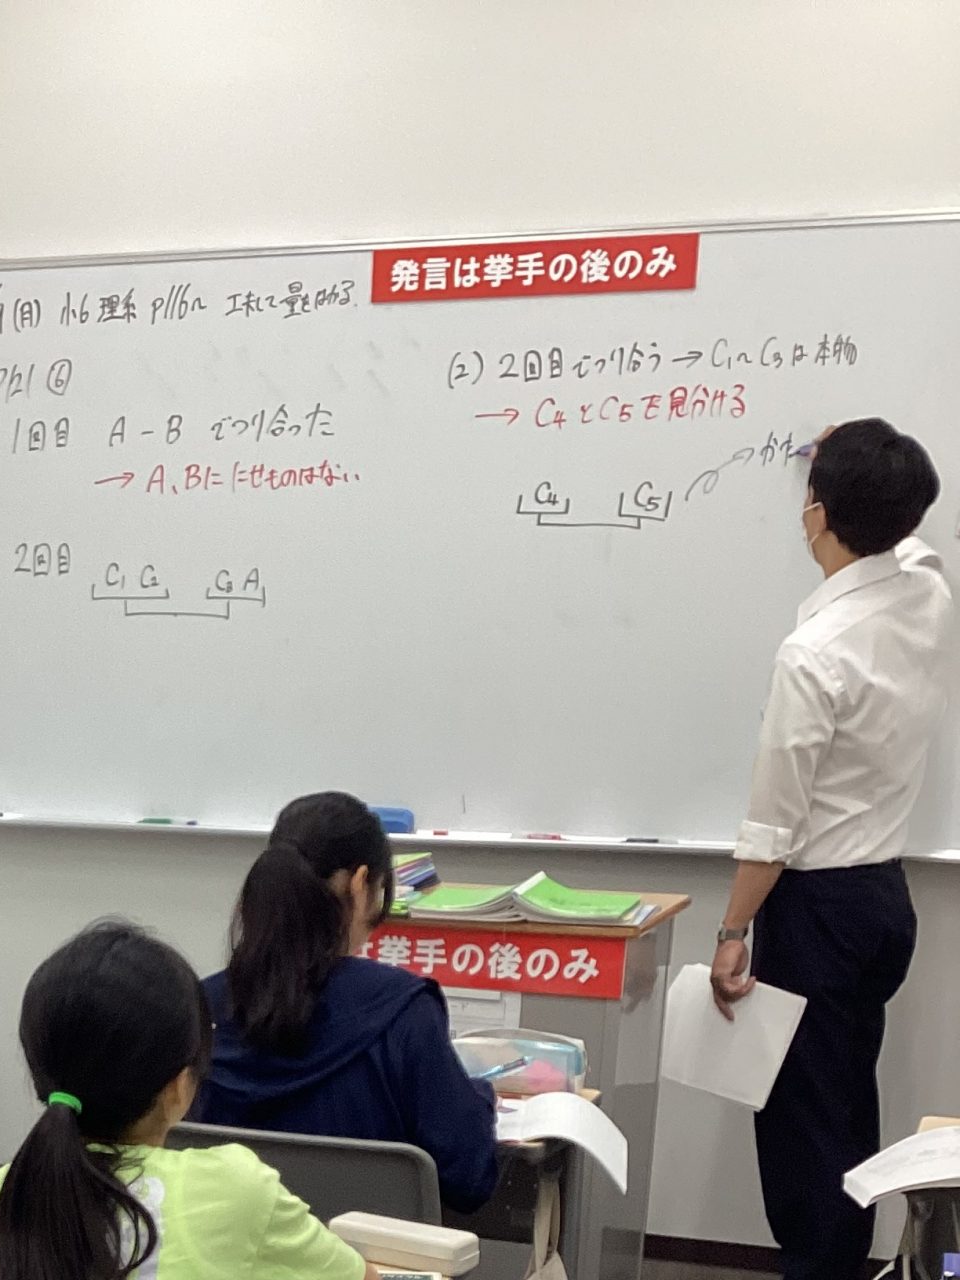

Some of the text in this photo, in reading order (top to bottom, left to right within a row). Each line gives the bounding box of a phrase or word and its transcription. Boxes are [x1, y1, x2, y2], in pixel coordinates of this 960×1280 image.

[391, 245, 677, 293] 発言は挙手の後のみ
